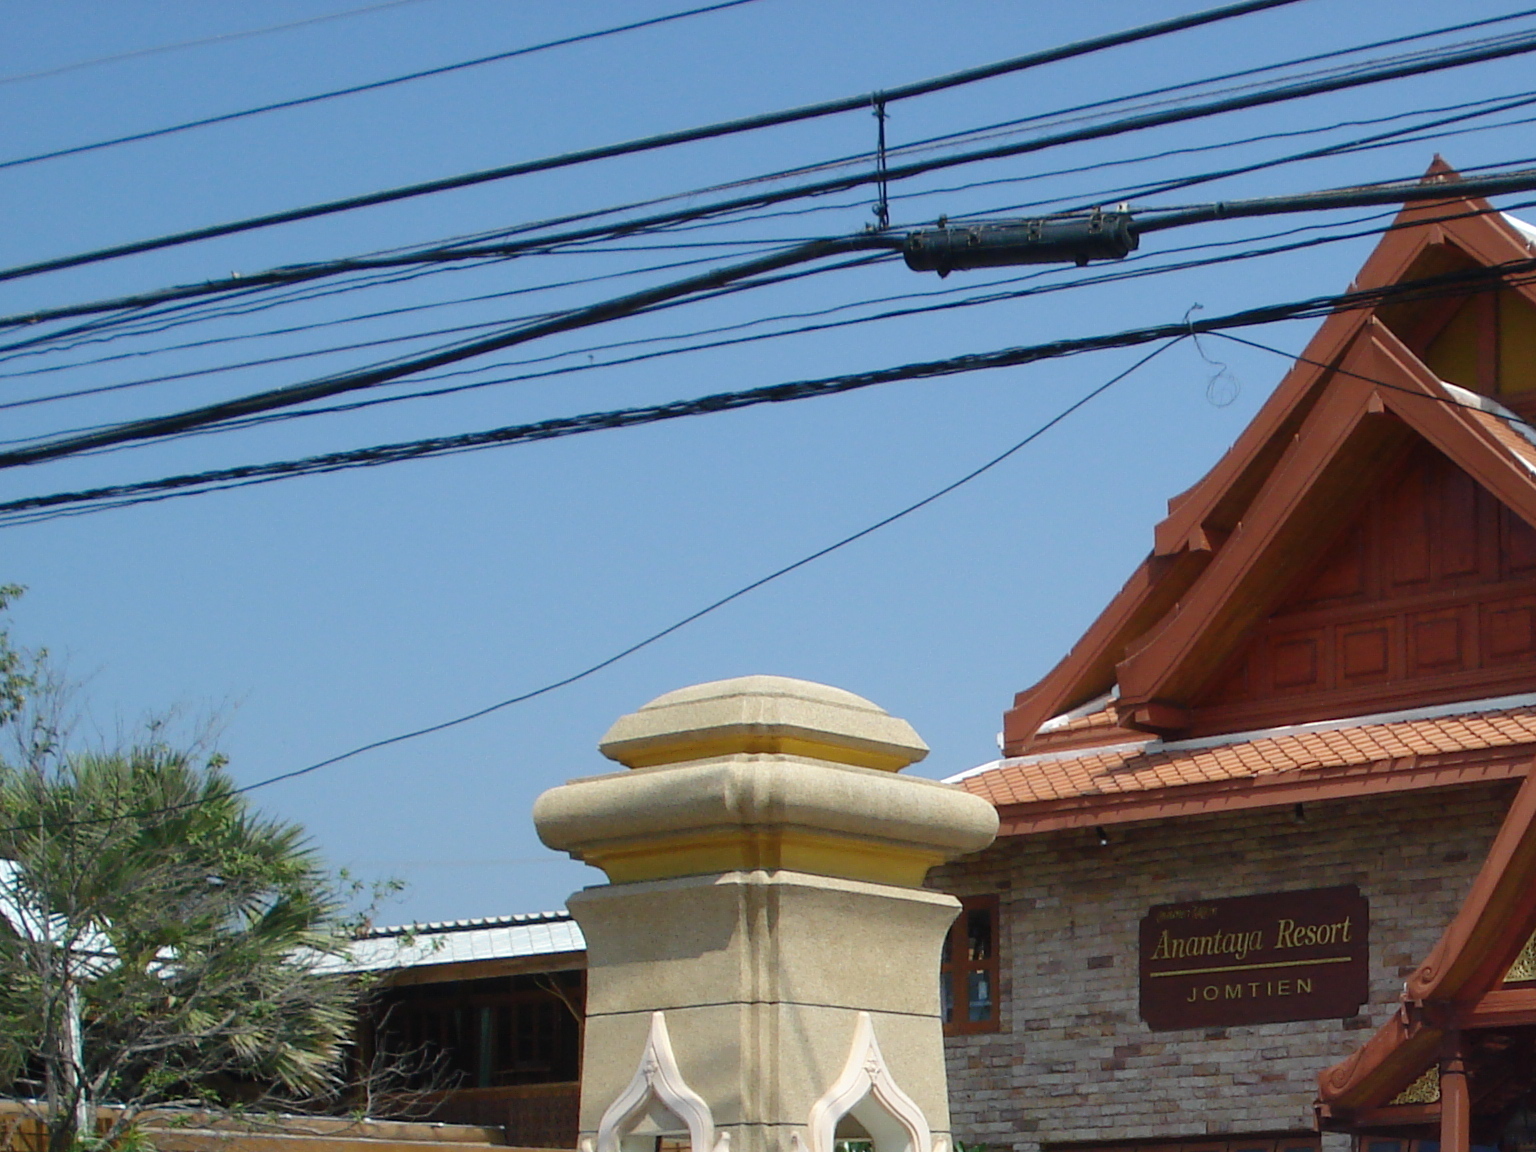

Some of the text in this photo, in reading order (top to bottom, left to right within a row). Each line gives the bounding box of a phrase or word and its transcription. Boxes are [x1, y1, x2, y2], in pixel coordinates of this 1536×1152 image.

[1150, 916, 1352, 960] Anantaya Resort
[1187, 978, 1313, 1002] JOMTIEN
